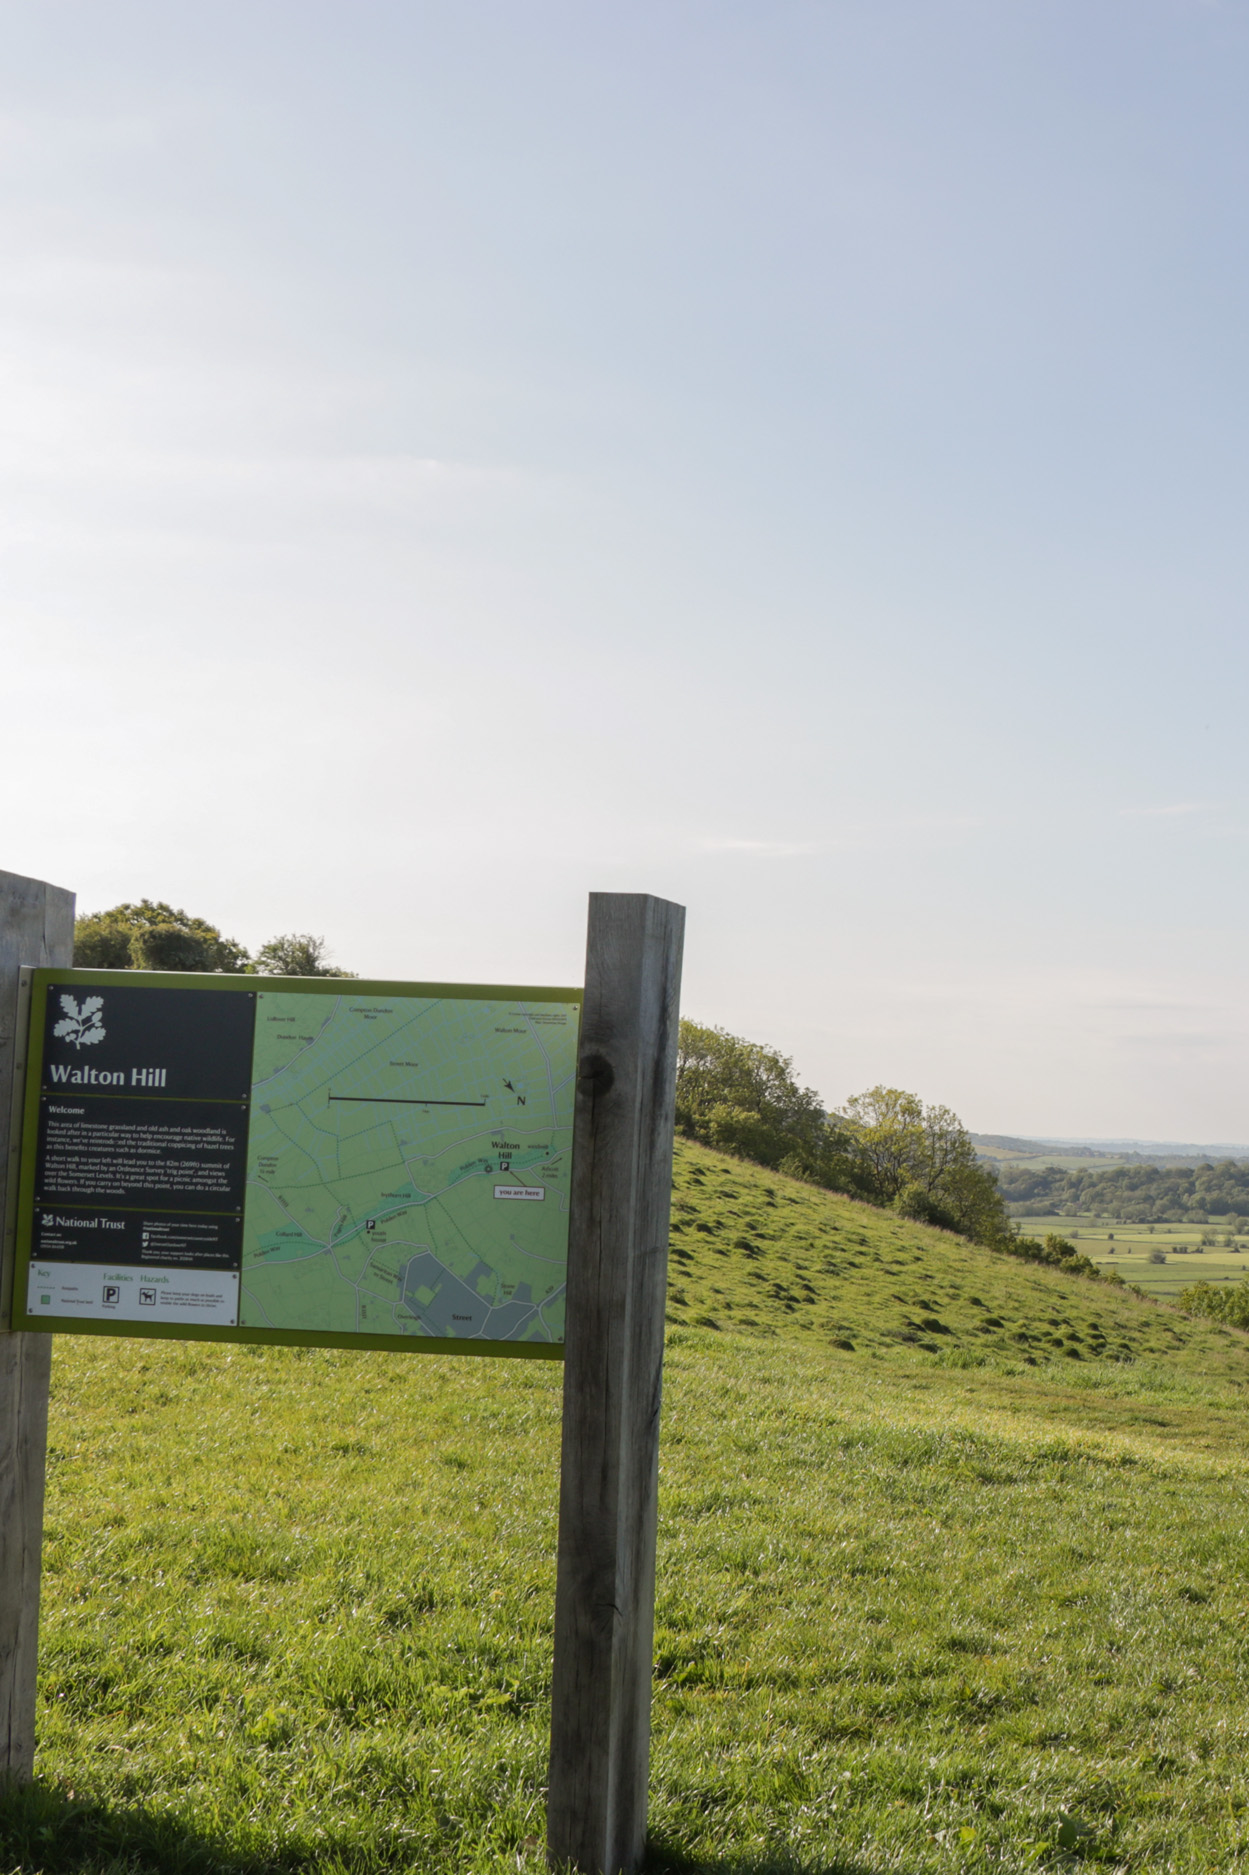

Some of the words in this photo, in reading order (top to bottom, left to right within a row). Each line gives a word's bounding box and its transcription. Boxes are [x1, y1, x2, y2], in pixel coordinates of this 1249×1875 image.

[50, 1064, 124, 1085] Walton
[132, 1068, 166, 1087] Hill
[517, 1096, 526, 1105] N
[48, 1106, 85, 1114] Welcome
[109, 1123, 136, 1132] grassland
[92, 1130, 119, 1139] particular
[140, 1132, 152, 1140] help
[47, 1136, 72, 1144] instance,
[168, 1141, 195, 1150] coppicing
[492, 1141, 520, 1150] Walton
[498, 1151, 512, 1159] Hill
[66, 1163, 77, 1171] Hill,
[116, 1165, 144, 1173] Ordnance
[145, 1167, 164, 1175] Survey
[130, 1173, 144, 1181] great
[146, 1174, 159, 1182] spot
[174, 1175, 191, 1184] picnic
[192, 1176, 216, 1185] amongst
[121, 1180, 142, 1189] beyond
[155, 1182, 172, 1190] point,
[72, 1186, 94, 1194] through
[56, 1216, 98, 1228] National
[99, 1218, 125, 1229] Trust
[38, 1269, 50, 1278] Key
[103, 1273, 133, 1282] Facilities
[140, 1274, 170, 1283] Hazards
[106, 1288, 116, 1301] P
